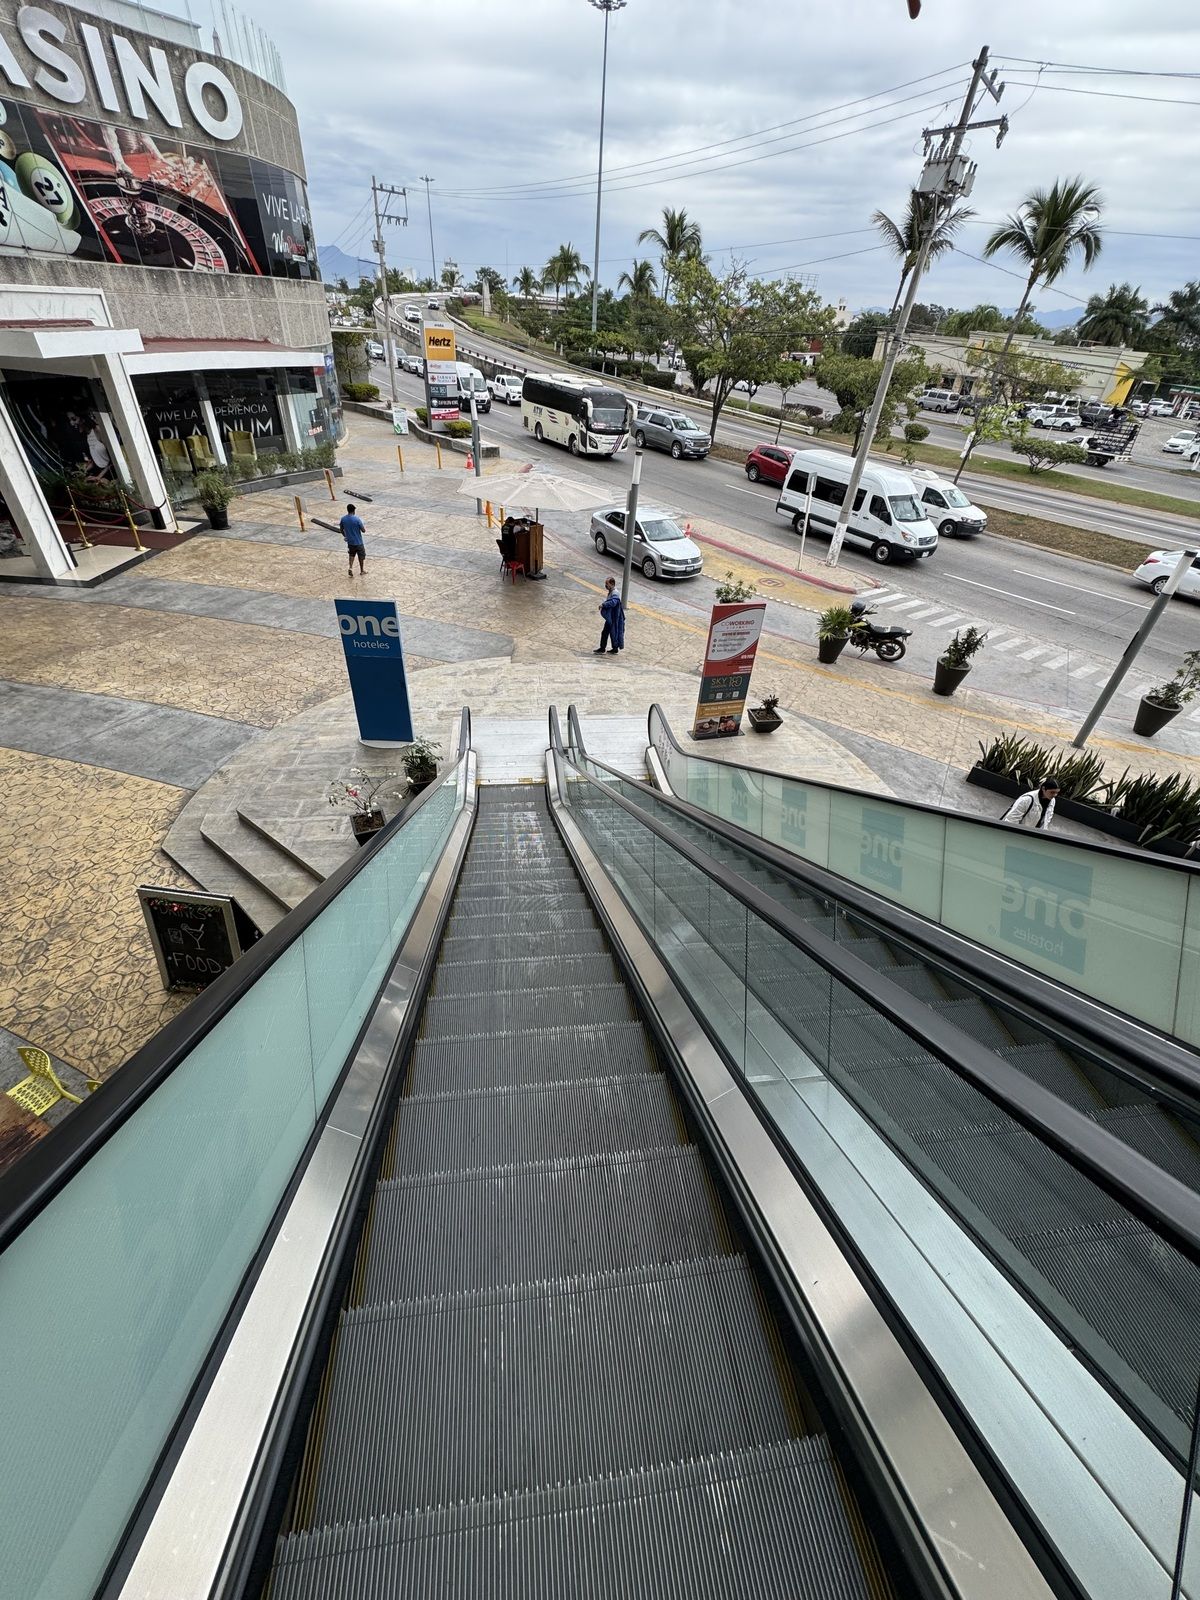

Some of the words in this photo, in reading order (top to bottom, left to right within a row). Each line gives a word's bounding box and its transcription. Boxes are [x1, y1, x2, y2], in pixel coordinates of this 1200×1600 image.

[262, 192, 289, 220] VIVE
[428, 336, 451, 347] Hertz
[156, 408, 181, 422] VIVE
[184, 408, 198, 420] LA
[338, 614, 400, 638] one
[353, 639, 390, 650] hoteles
[711, 677, 727, 686] SKY
[172, 952, 222, 974] FOOD
